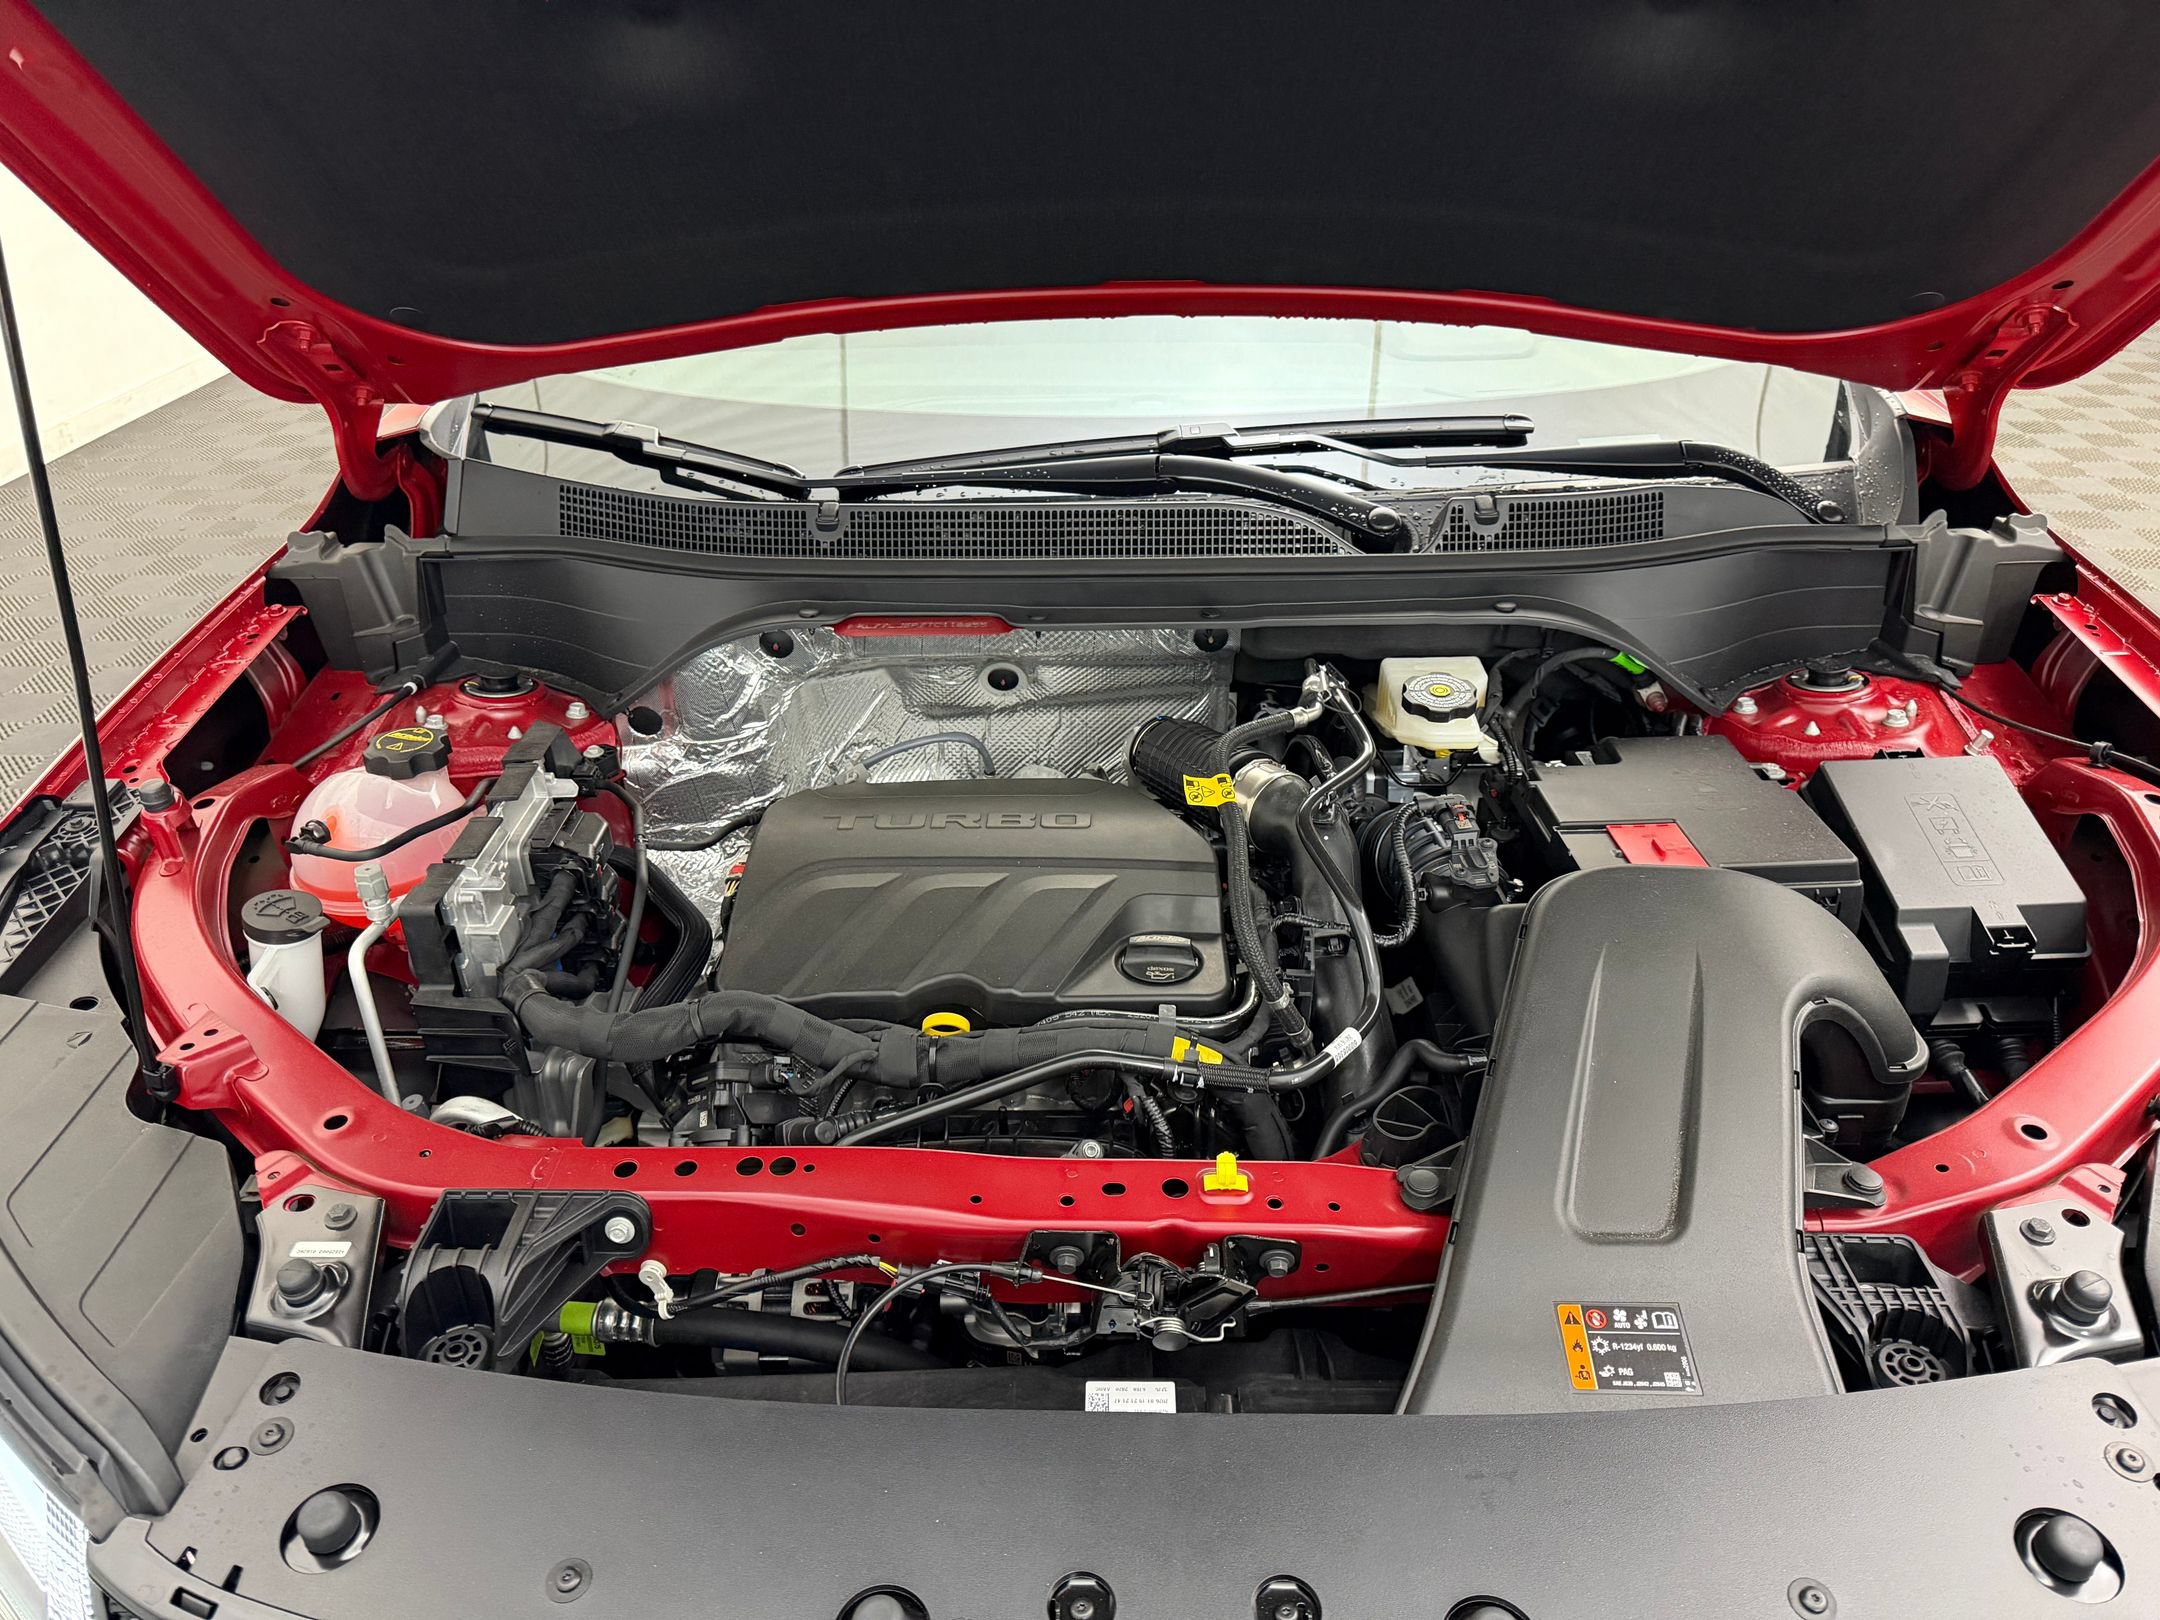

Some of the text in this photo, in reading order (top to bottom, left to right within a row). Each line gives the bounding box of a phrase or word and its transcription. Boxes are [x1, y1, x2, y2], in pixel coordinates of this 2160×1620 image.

[823, 812, 1092, 830] TURBO
[1614, 1321, 1631, 1329] AUTO
[1667, 1343, 1677, 1353] kg
[1618, 1367, 1634, 1376] PAG
